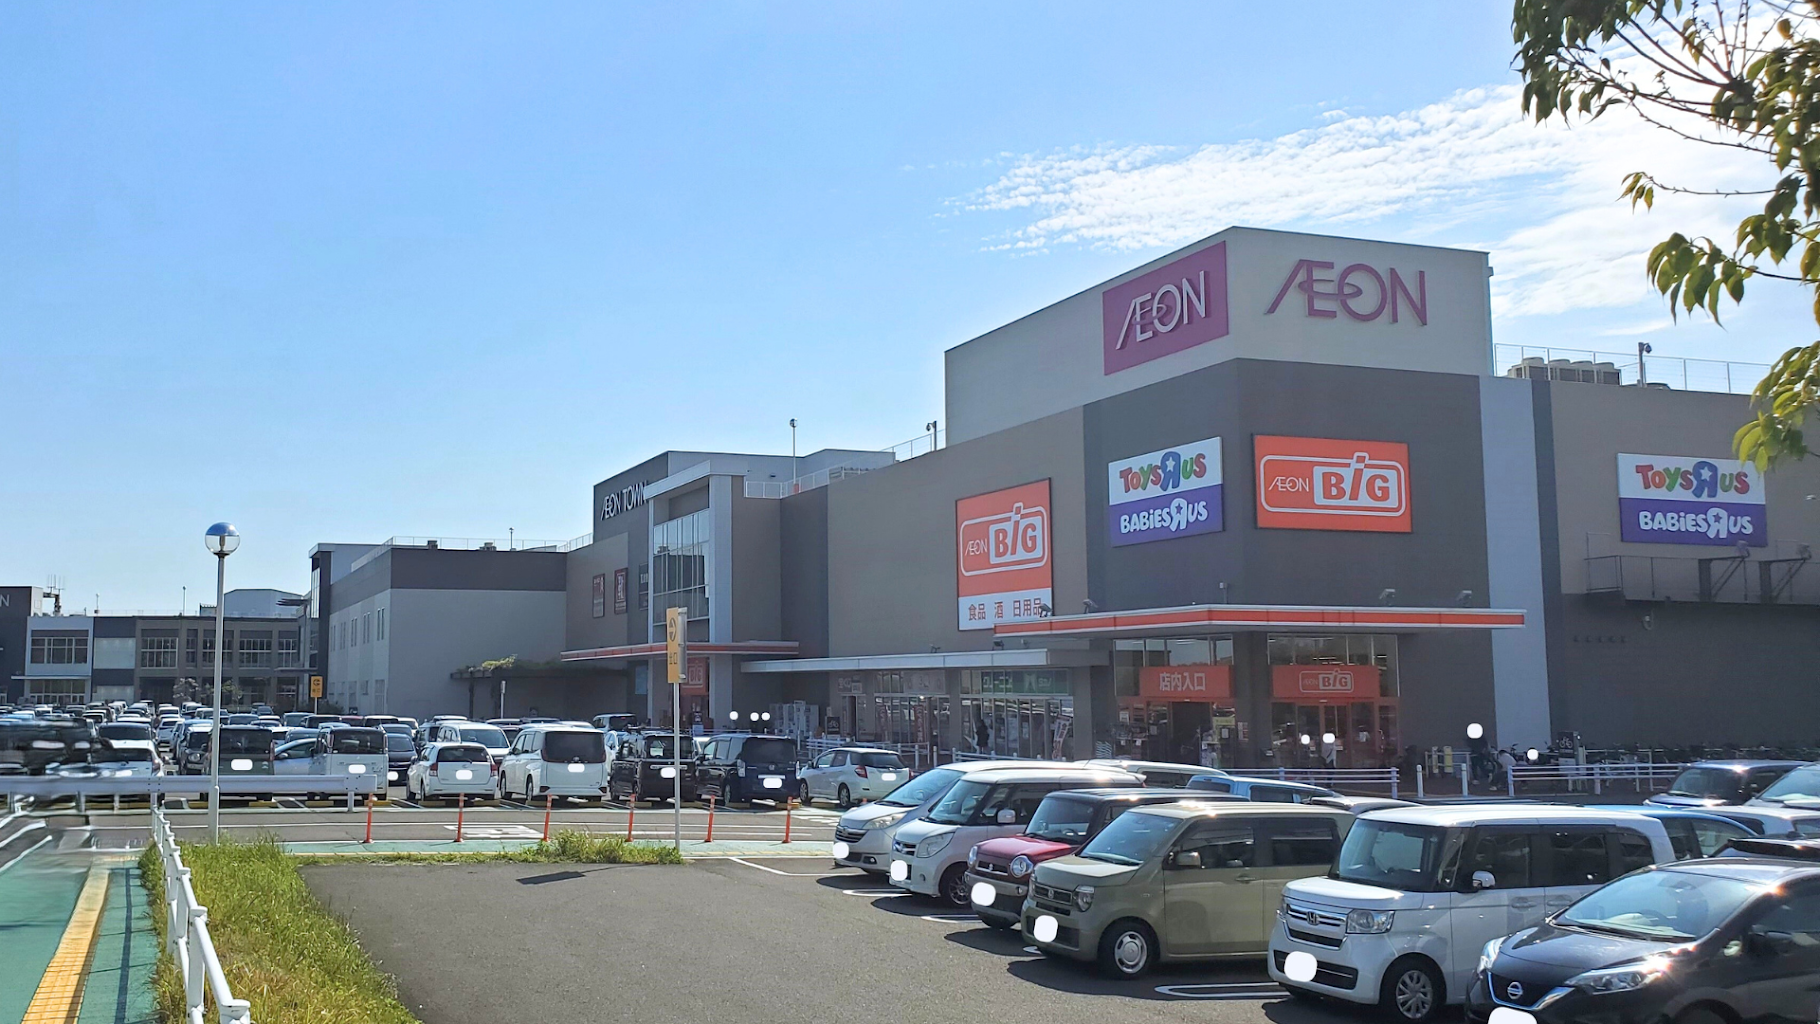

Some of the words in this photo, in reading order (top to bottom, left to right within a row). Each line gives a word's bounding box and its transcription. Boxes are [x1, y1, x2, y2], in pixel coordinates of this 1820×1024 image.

[1264, 259, 1428, 326] AEON
[1115, 269, 1207, 350] AEON
[622, 480, 647, 512] TOWN
[1268, 476, 1309, 492] AEON
[965, 538, 988, 556] AEON
[968, 603, 986, 621] 食品
[994, 601, 1004, 619] 酒
[1013, 597, 1042, 618] 日用品
[1159, 671, 1206, 692] 店内入口
